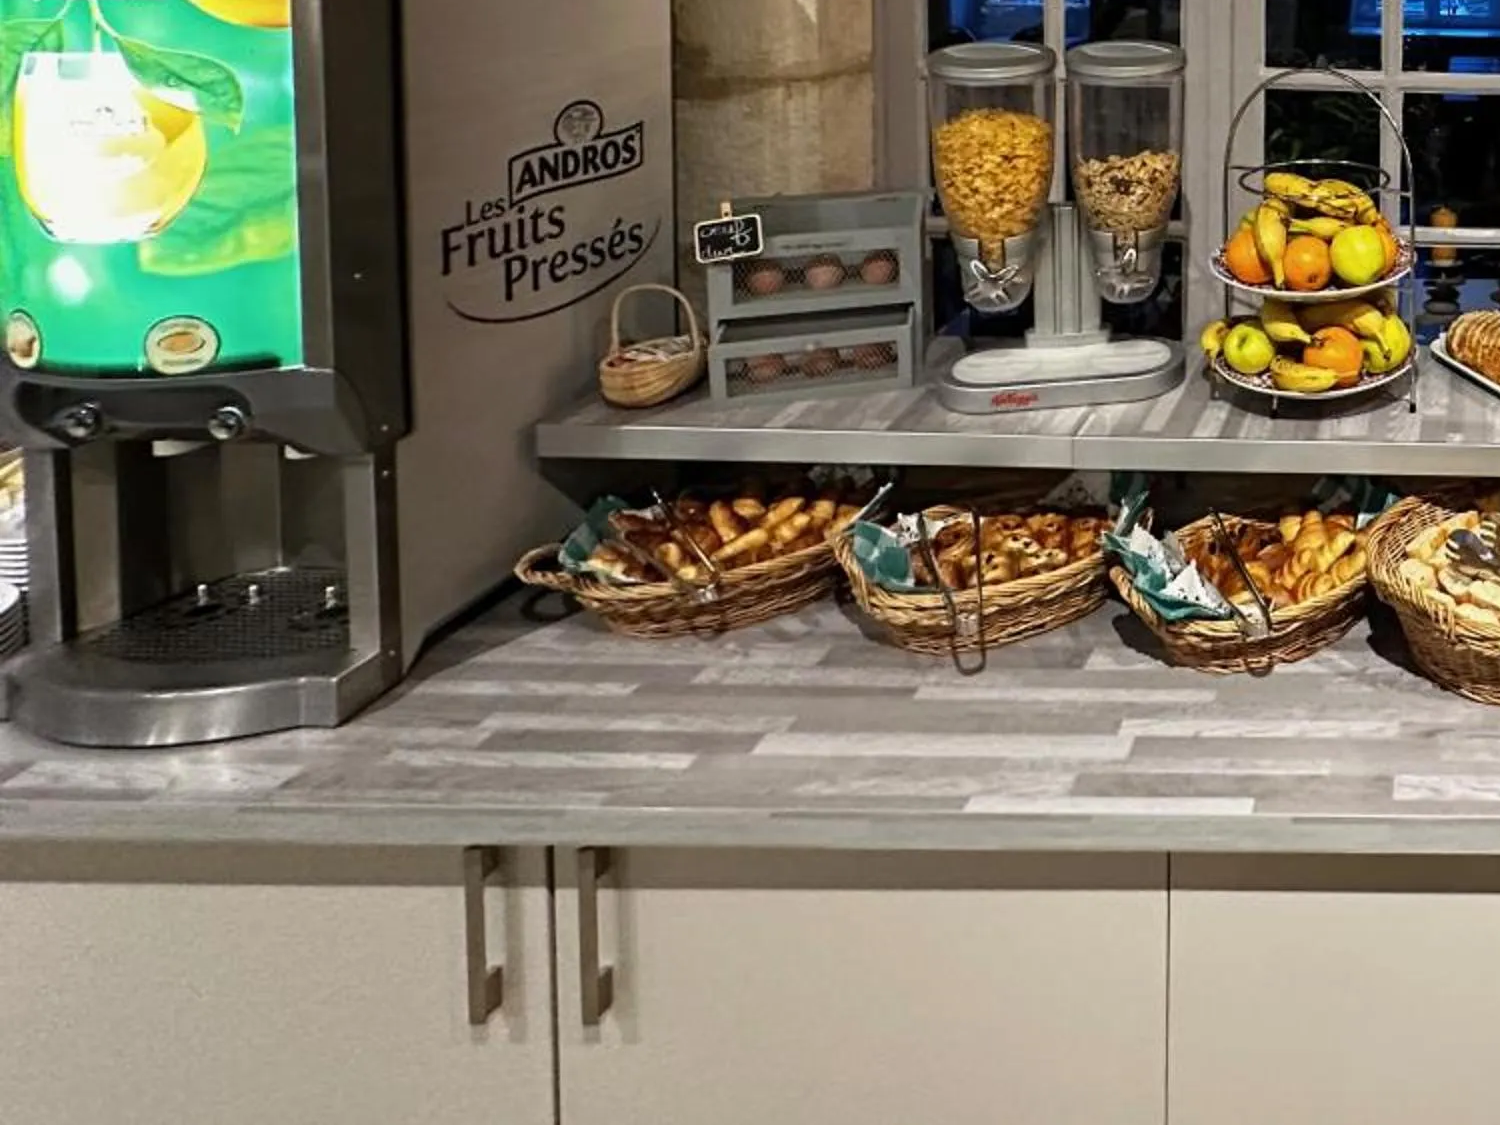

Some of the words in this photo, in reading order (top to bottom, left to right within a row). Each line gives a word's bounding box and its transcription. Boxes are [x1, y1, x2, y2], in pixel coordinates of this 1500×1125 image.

[515, 133, 637, 194] ANDROS
[441, 205, 566, 276] Fruits
[465, 197, 506, 226] Les
[504, 217, 644, 302] Pressés
